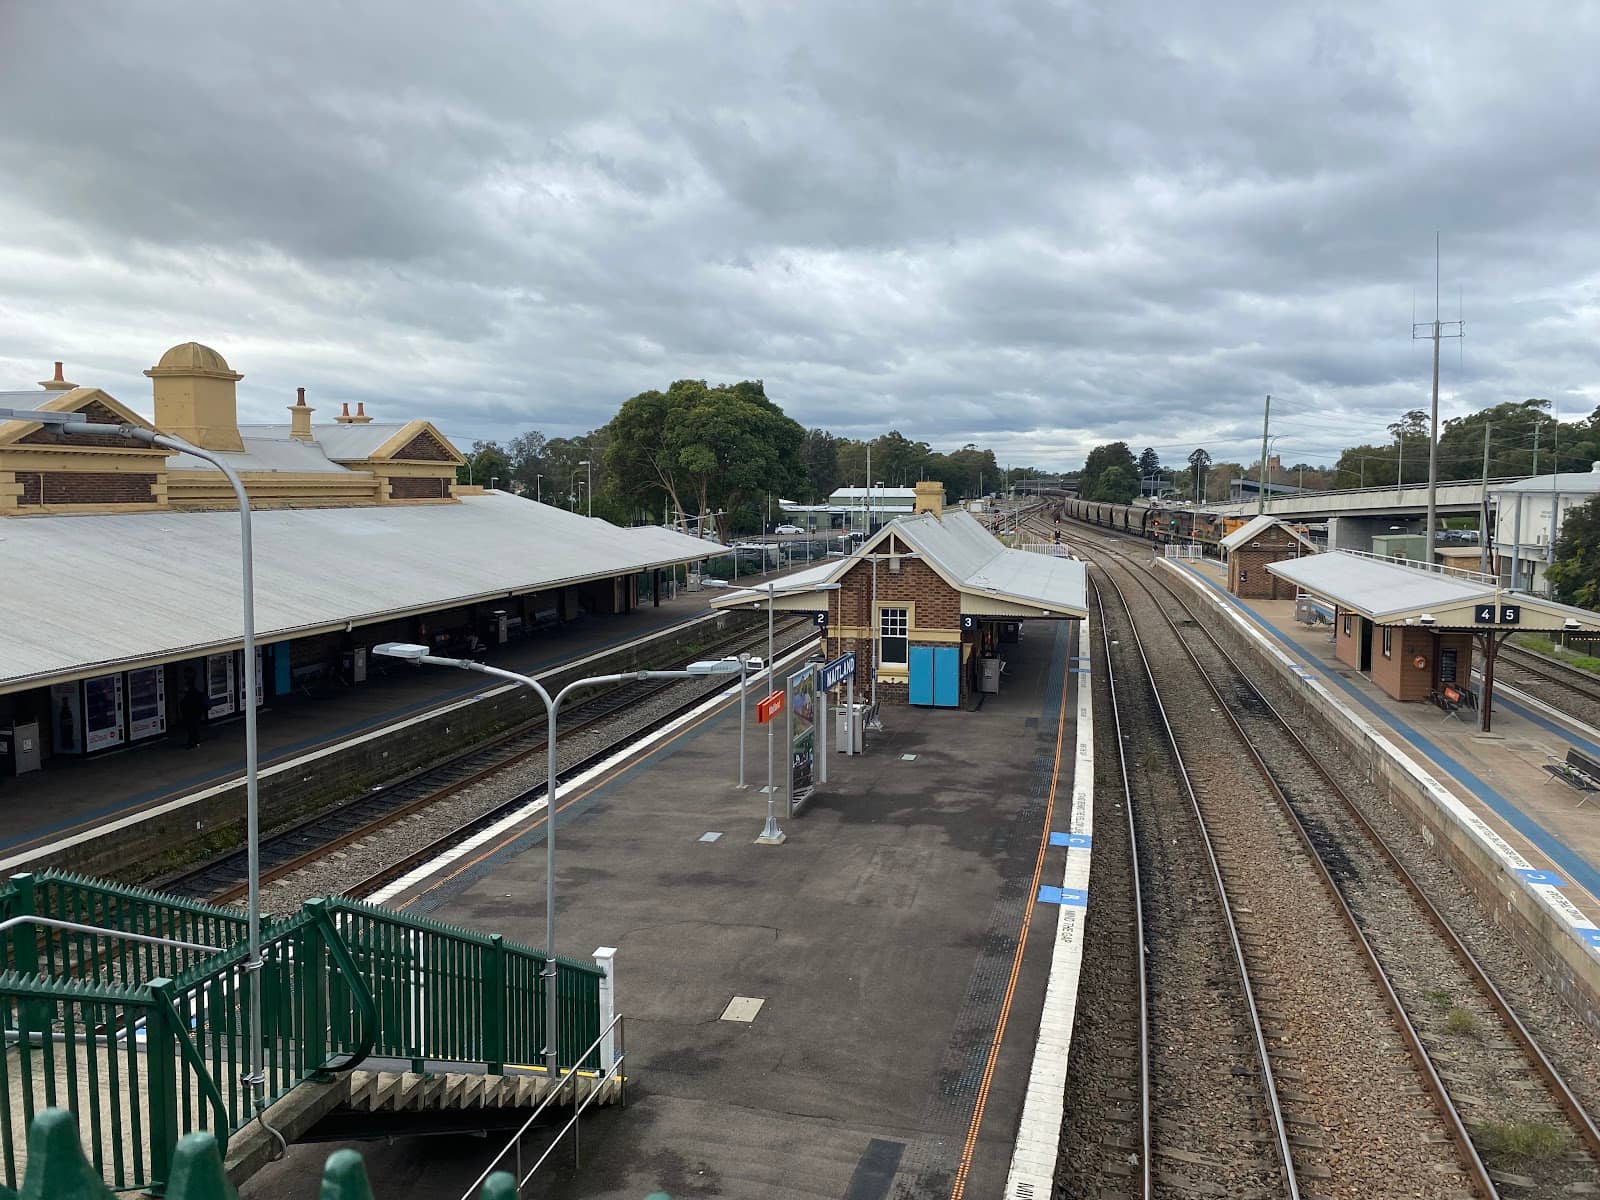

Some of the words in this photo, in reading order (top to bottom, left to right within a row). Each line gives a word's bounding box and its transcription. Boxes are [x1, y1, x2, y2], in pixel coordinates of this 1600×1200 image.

[817, 613, 825, 623] 2
[1481, 609, 1490, 620] 4
[1506, 609, 1514, 620] 5
[964, 617, 972, 627] 3
[827, 657, 855, 688] MAITLAND
